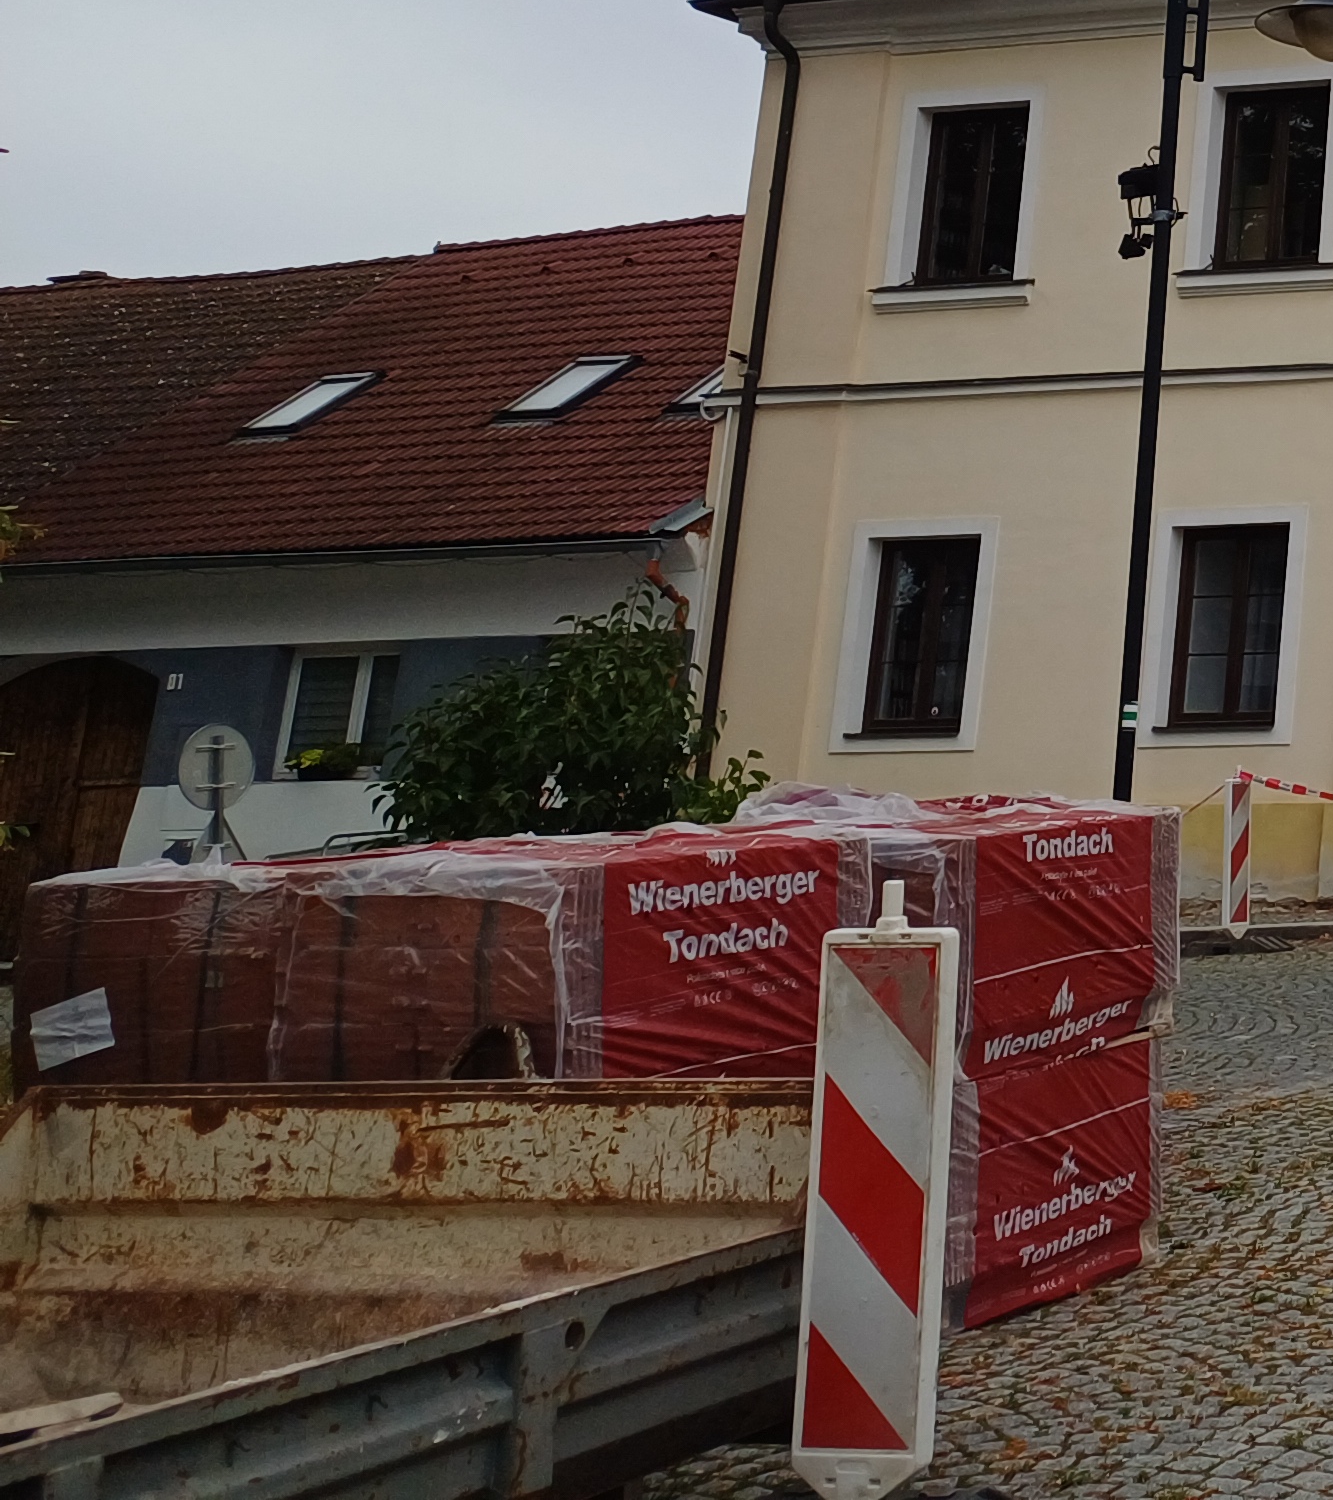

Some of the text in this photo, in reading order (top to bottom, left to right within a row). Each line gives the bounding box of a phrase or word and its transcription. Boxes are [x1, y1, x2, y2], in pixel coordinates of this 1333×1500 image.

[1022, 827, 1114, 863] Tondach
[627, 869, 821, 916] Wienerberger
[662, 916, 789, 964] Tondach
[983, 999, 1134, 1065] Wienerberger
[993, 1171, 1137, 1242] Wienerberger
[1018, 1214, 1113, 1269] Tondach
